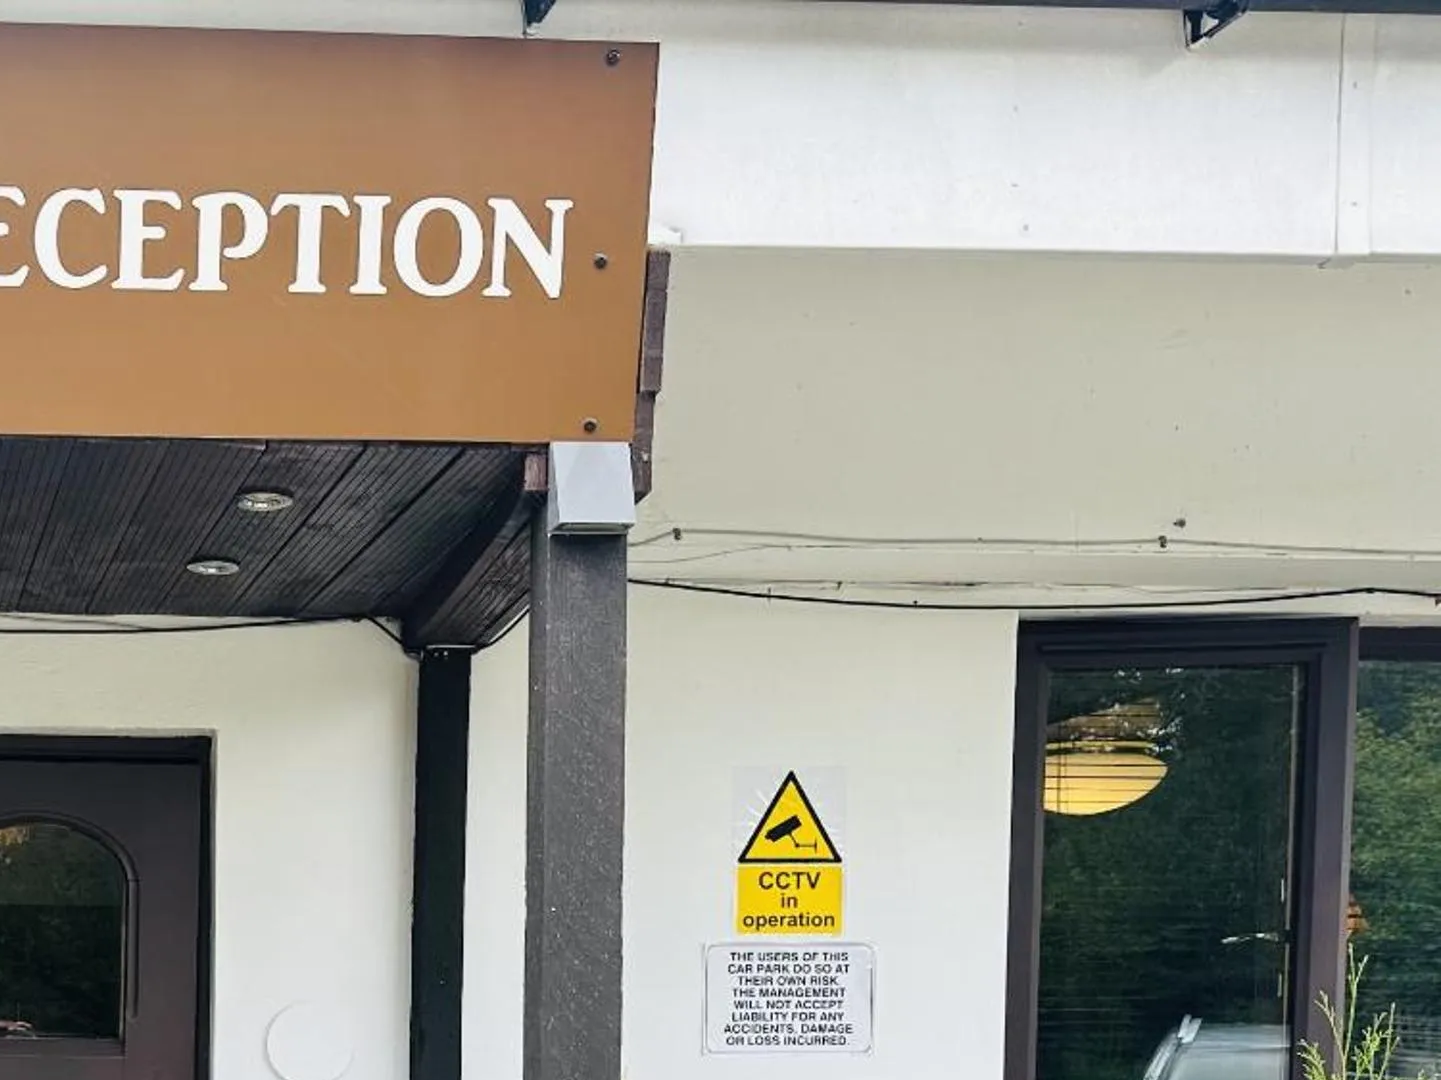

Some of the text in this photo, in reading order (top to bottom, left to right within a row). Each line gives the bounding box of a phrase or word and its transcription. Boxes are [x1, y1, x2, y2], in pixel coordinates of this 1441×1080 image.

[758, 871, 821, 890] CCTV
[780, 893, 798, 908] in
[743, 912, 835, 930] operation
[730, 952, 849, 961] THE USERS OF THIS
[728, 964, 850, 974] CAR PARK DO SO AT
[738, 976, 773, 985] THEIR
[776, 976, 806, 985] OWN
[733, 988, 846, 998] THE MANAGEMENT
[733, 1000, 844, 1009] WILL NOT ACCEPT
[732, 1012, 844, 1021] LIABILITY FOR ANY
[801, 1024, 853, 1034] DAMAGE
[726, 1035, 850, 1045] OR LOSS INCURRED.
